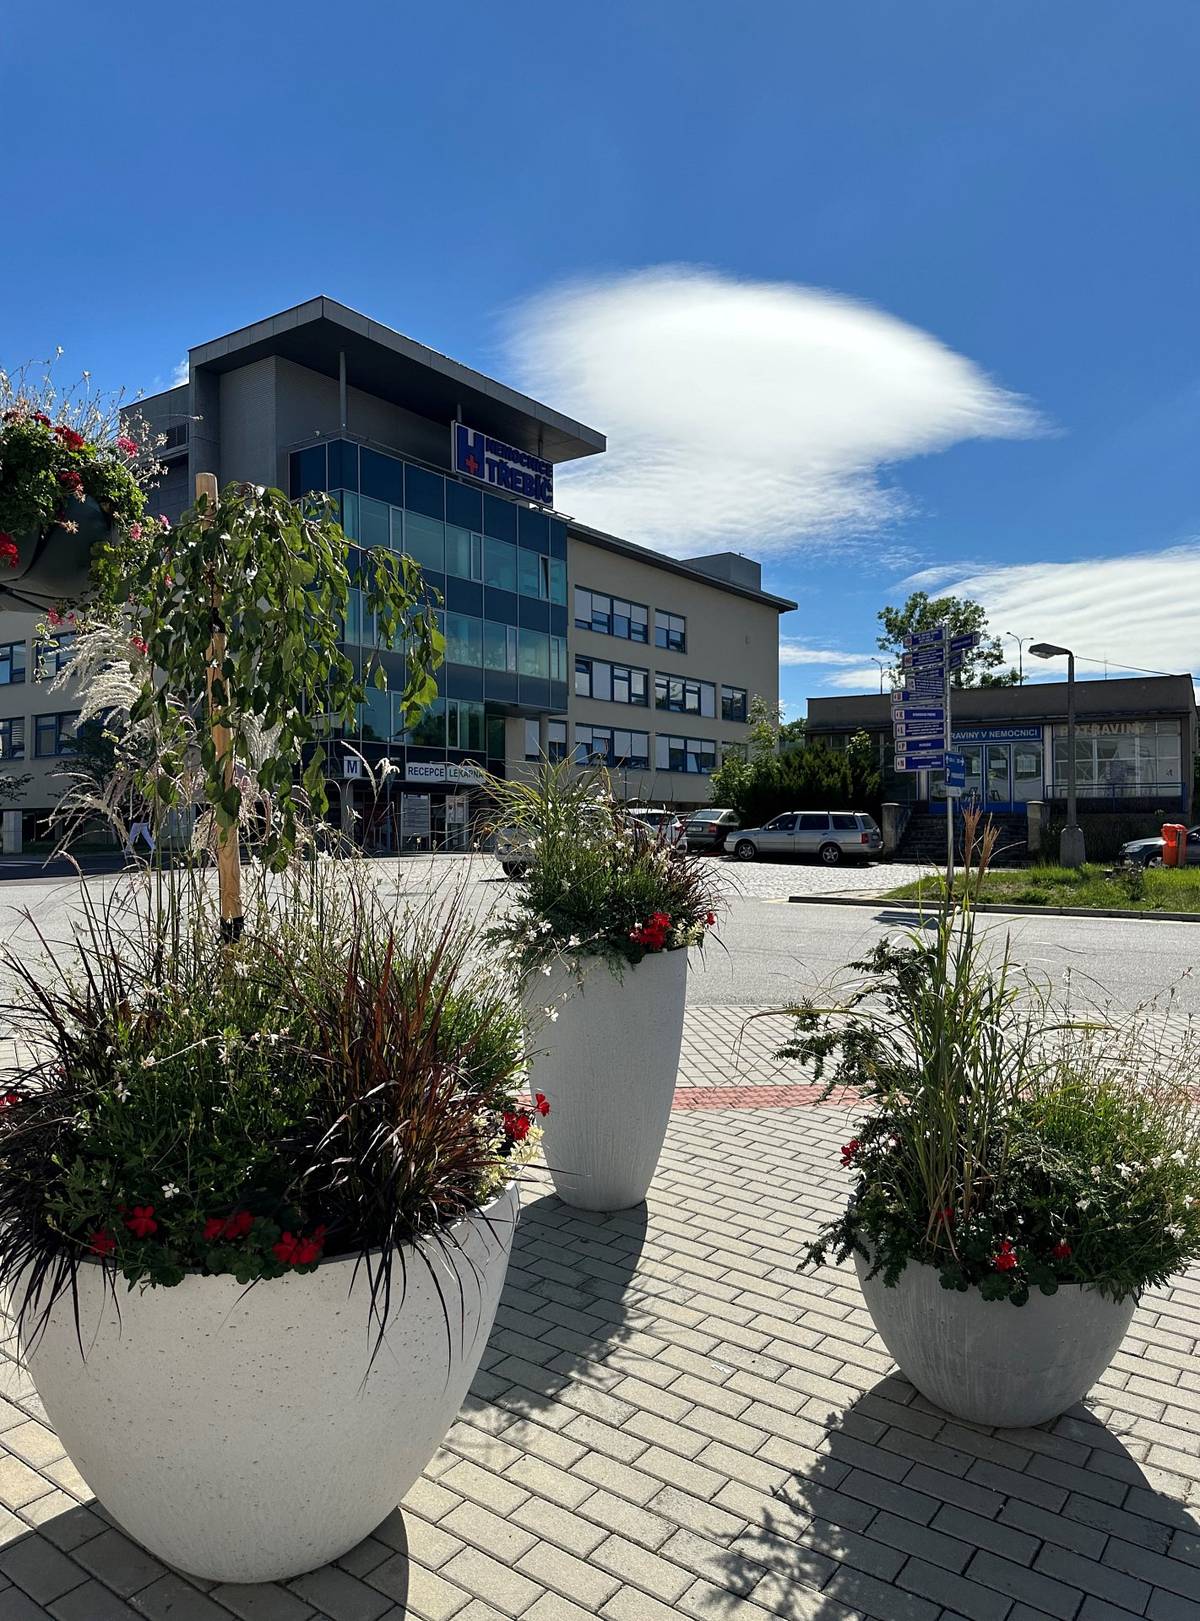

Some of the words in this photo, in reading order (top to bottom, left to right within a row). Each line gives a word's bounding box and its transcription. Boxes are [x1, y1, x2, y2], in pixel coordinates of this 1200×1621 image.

[485, 437, 553, 478] NEMOCNICE
[989, 729, 1037, 738] NEMOCNICI
[346, 760, 358, 774] M
[408, 766, 445, 777] RECEPCE
